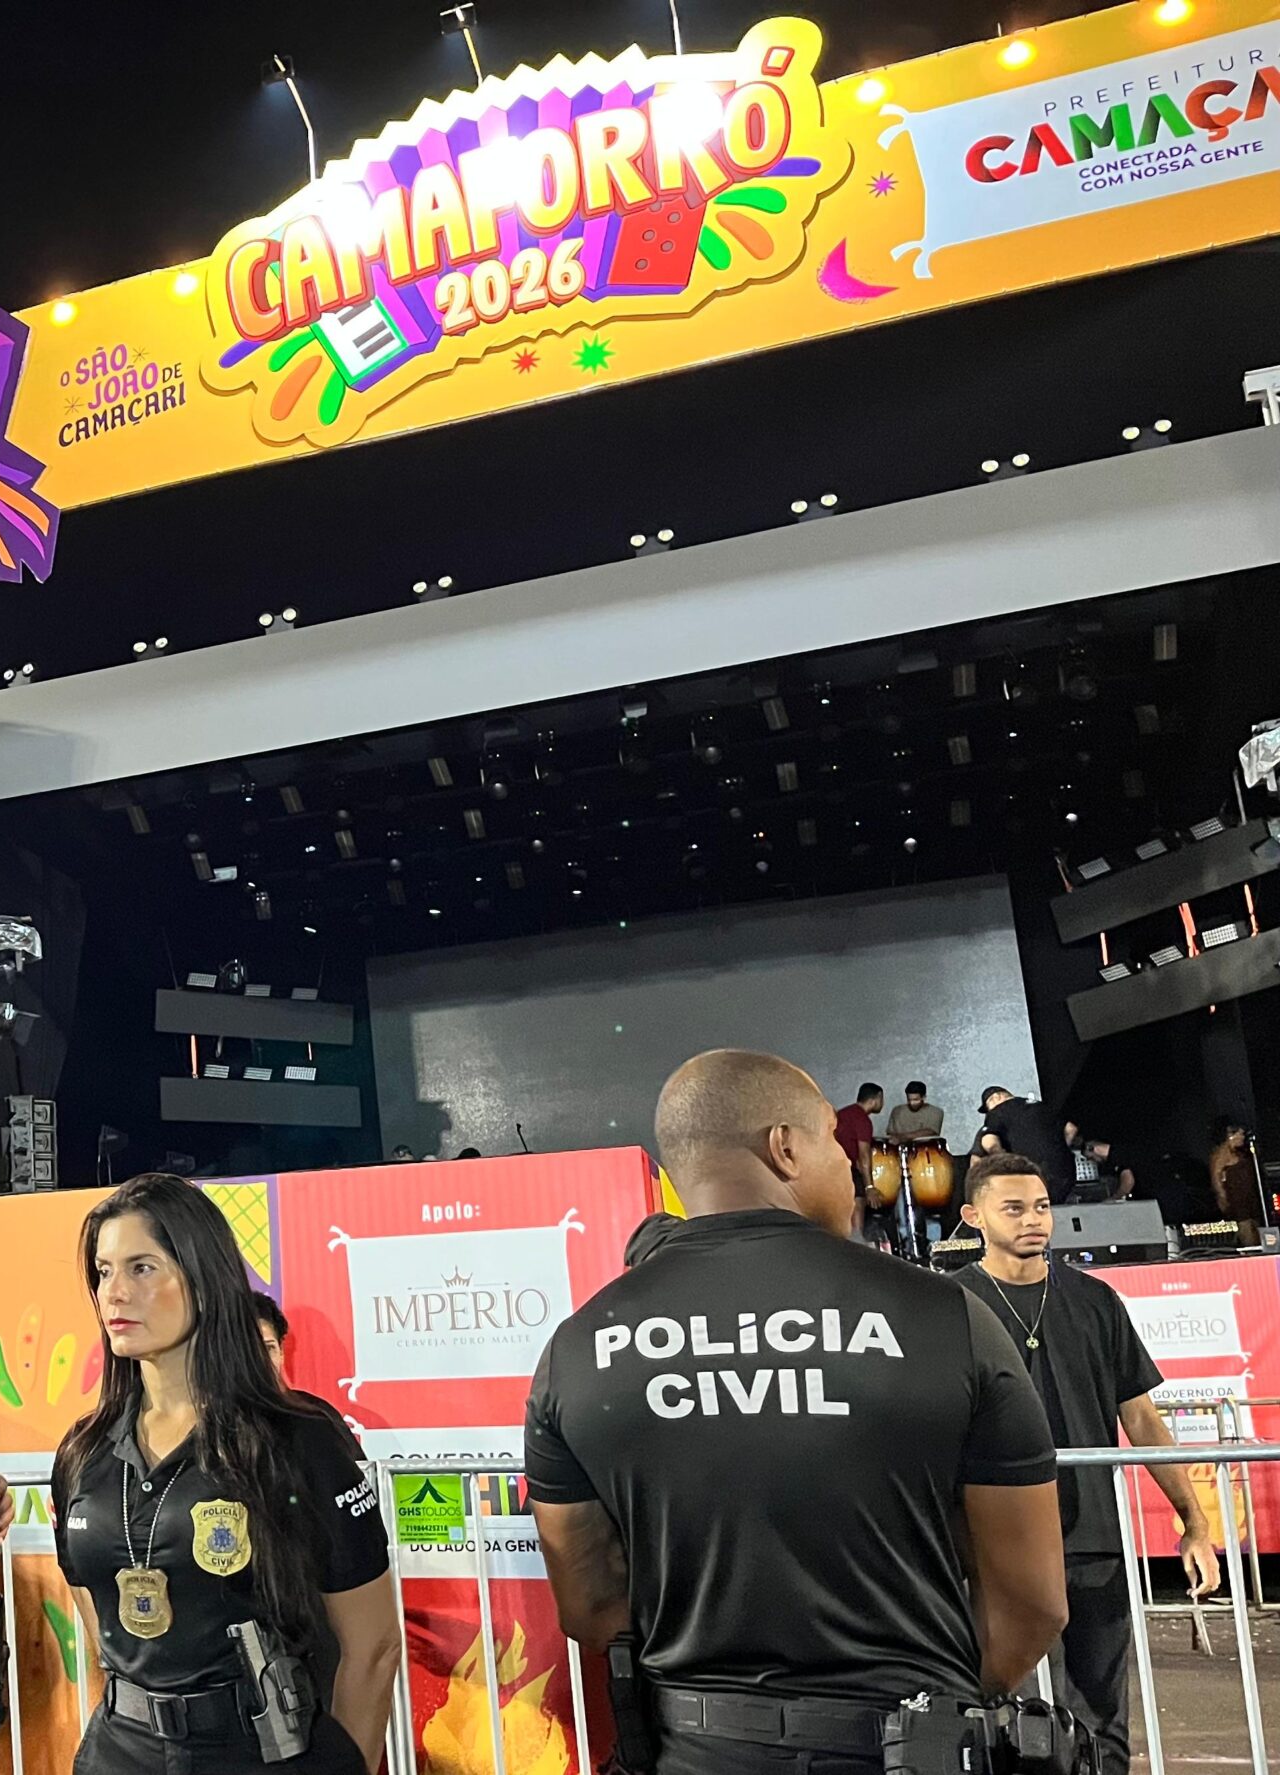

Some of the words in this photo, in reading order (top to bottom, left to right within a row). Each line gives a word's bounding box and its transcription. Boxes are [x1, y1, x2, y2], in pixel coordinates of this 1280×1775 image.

[1044, 49, 1280, 117] PREFEITUR
[1079, 142, 1197, 179] CONECTADA
[1081, 173, 1124, 192] COM
[1130, 160, 1195, 182] NOSSA
[1200, 141, 1264, 164] GENTE
[225, 46, 794, 342] CAMAFORRÓ
[435, 237, 585, 334] 2026
[75, 344, 128, 385] SÃO
[88, 362, 159, 410] JOÃO
[162, 362, 183, 384] DE
[58, 381, 186, 447] CAMAÇARI
[396, 1337, 447, 1348] CERVEJA
[453, 1336, 485, 1346] PURO
[492, 1334, 531, 1344] MALTE
[594, 1308, 904, 1369] POLÍCIA
[645, 1367, 850, 1419] CIVIL
[1153, 1387, 1214, 1400] GOVERNO
[1217, 1386, 1235, 1396] DA
